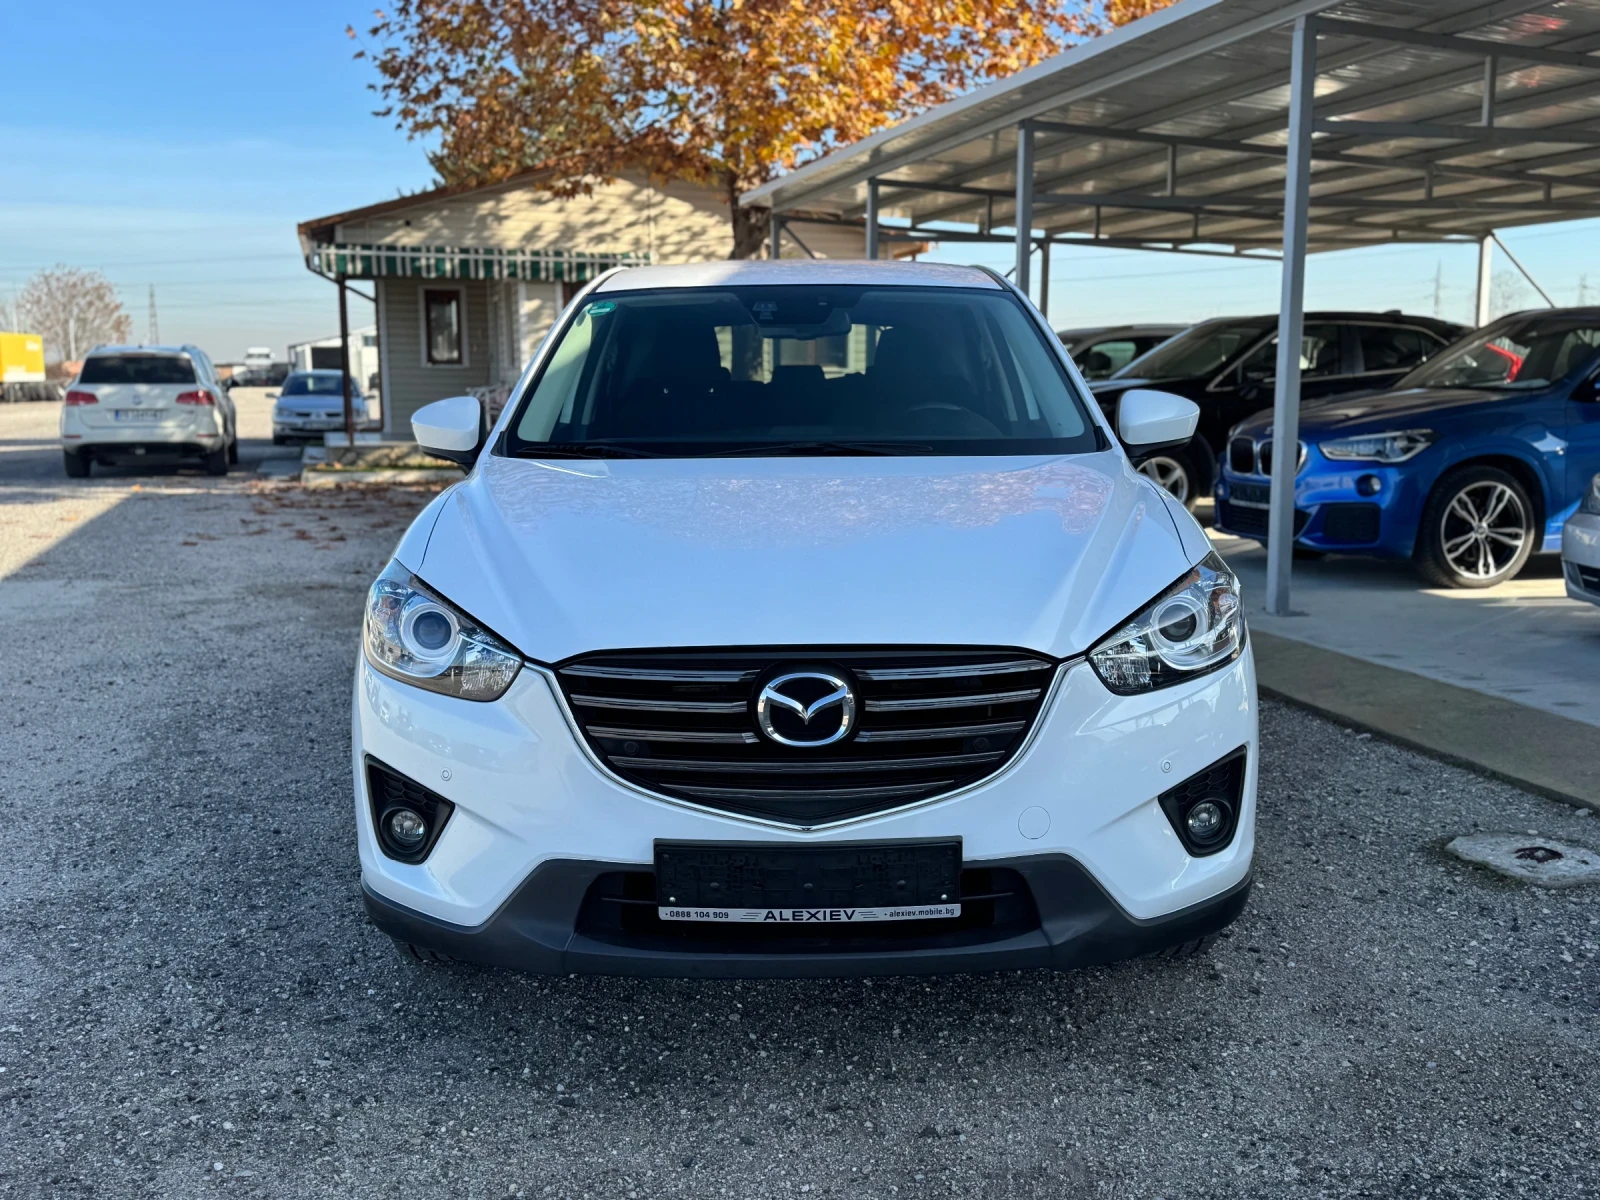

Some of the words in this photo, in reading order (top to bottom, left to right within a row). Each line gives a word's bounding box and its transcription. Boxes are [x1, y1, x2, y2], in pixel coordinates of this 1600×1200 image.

[669, 910, 691, 918] 0888
[694, 911, 710, 919] 104
[712, 911, 729, 919] 909
[763, 909, 856, 921] ALEXIEV
[889, 907, 955, 918] alexiev.mobile.bg
